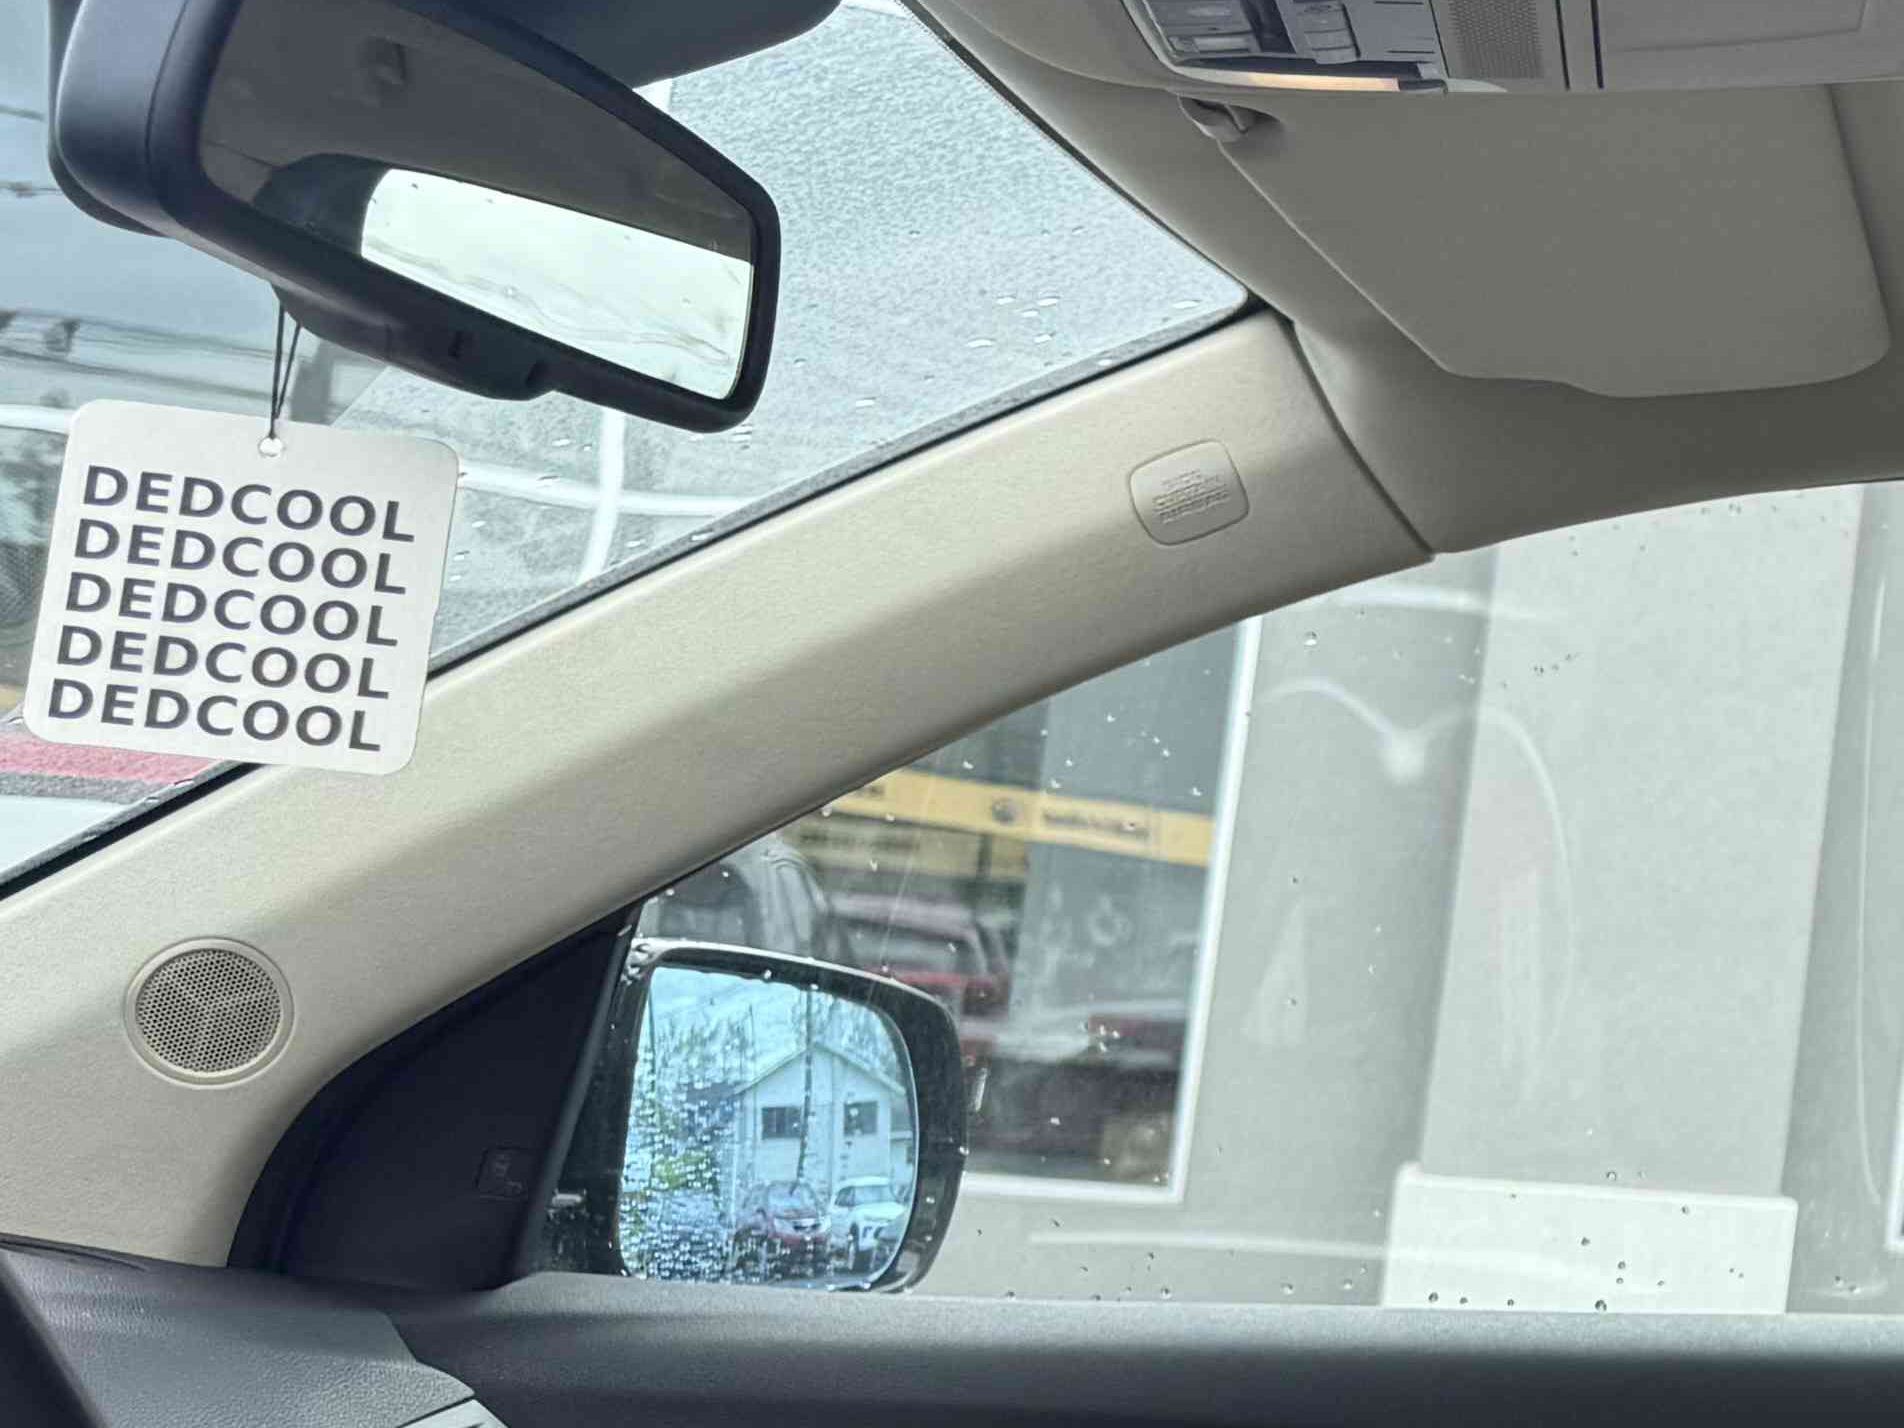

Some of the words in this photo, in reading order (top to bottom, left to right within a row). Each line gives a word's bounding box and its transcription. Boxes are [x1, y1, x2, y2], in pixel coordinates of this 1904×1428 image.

[83, 464, 415, 543] DEDCOOL
[74, 518, 406, 595] DEDCOOL
[65, 571, 398, 647] DEDCOOL
[56, 624, 389, 700] DEDCOOL
[48, 677, 381, 752] DEDCOOL
